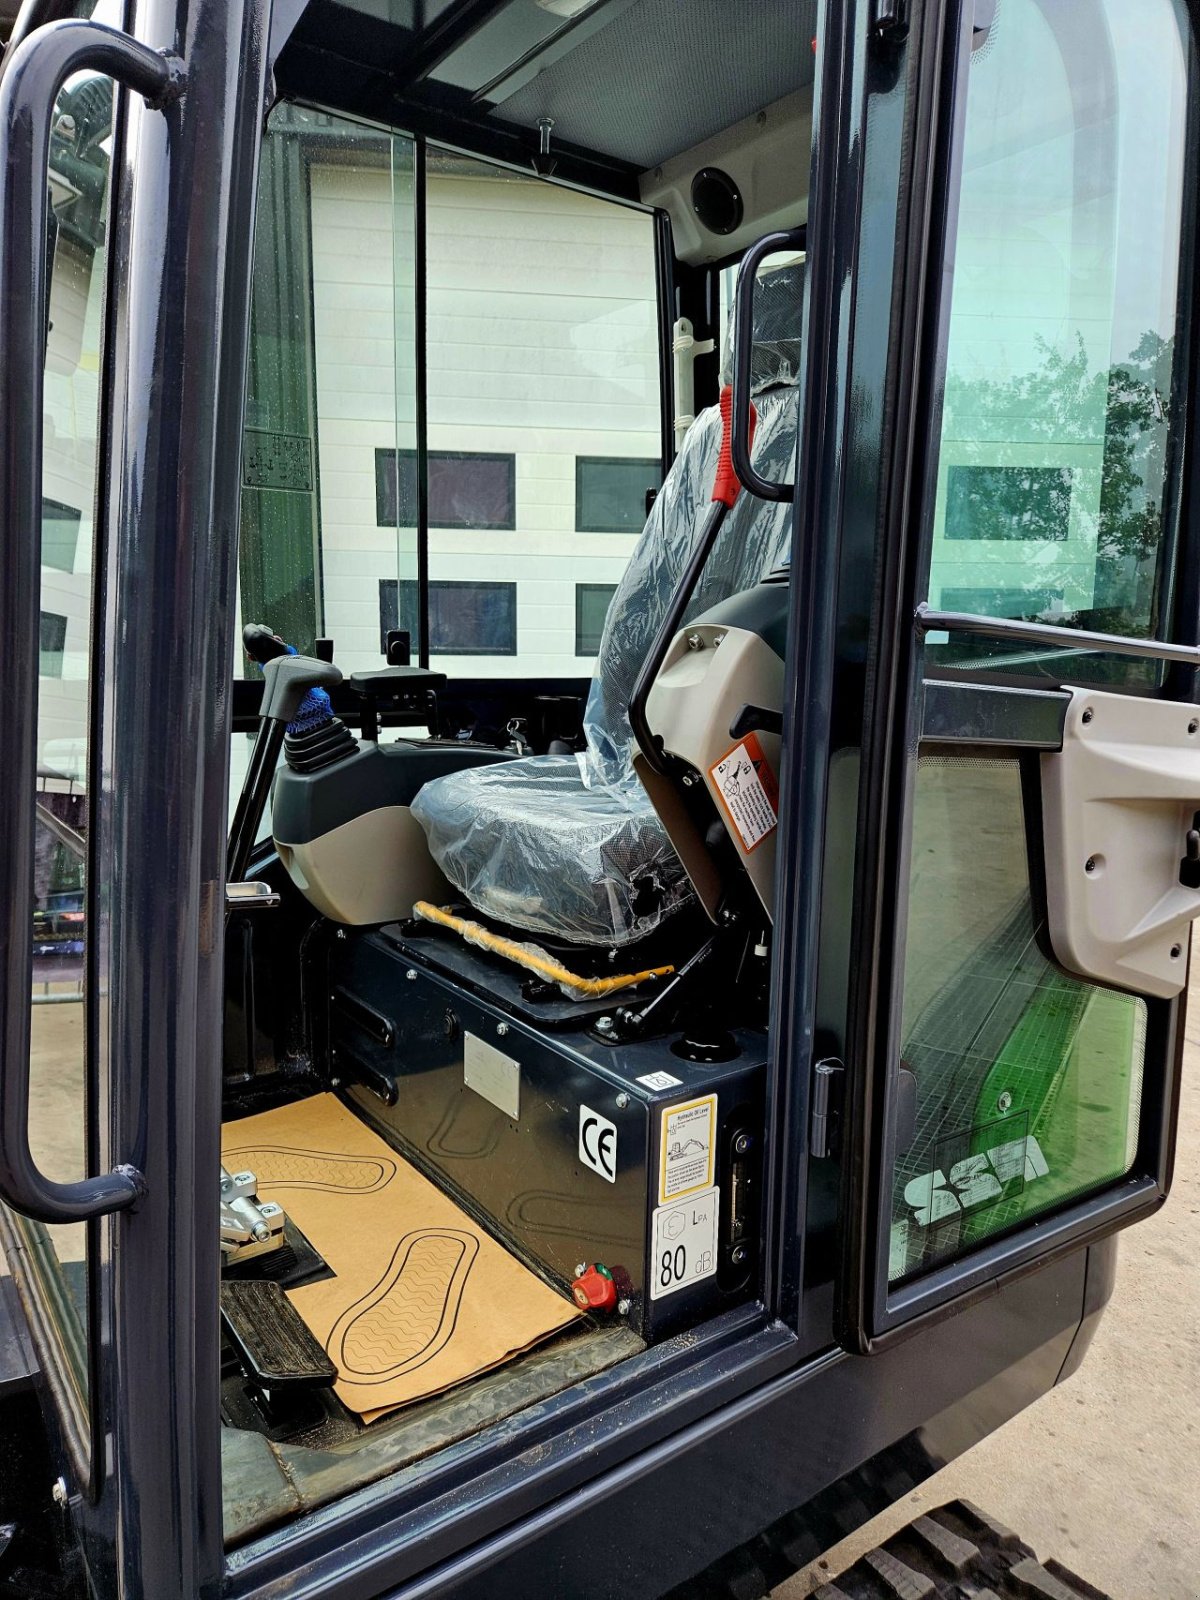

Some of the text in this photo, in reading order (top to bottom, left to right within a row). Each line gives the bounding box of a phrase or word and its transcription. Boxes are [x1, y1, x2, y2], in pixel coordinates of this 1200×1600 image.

[582, 1117, 615, 1177] CE
[660, 1244, 712, 1287] 80 dB
